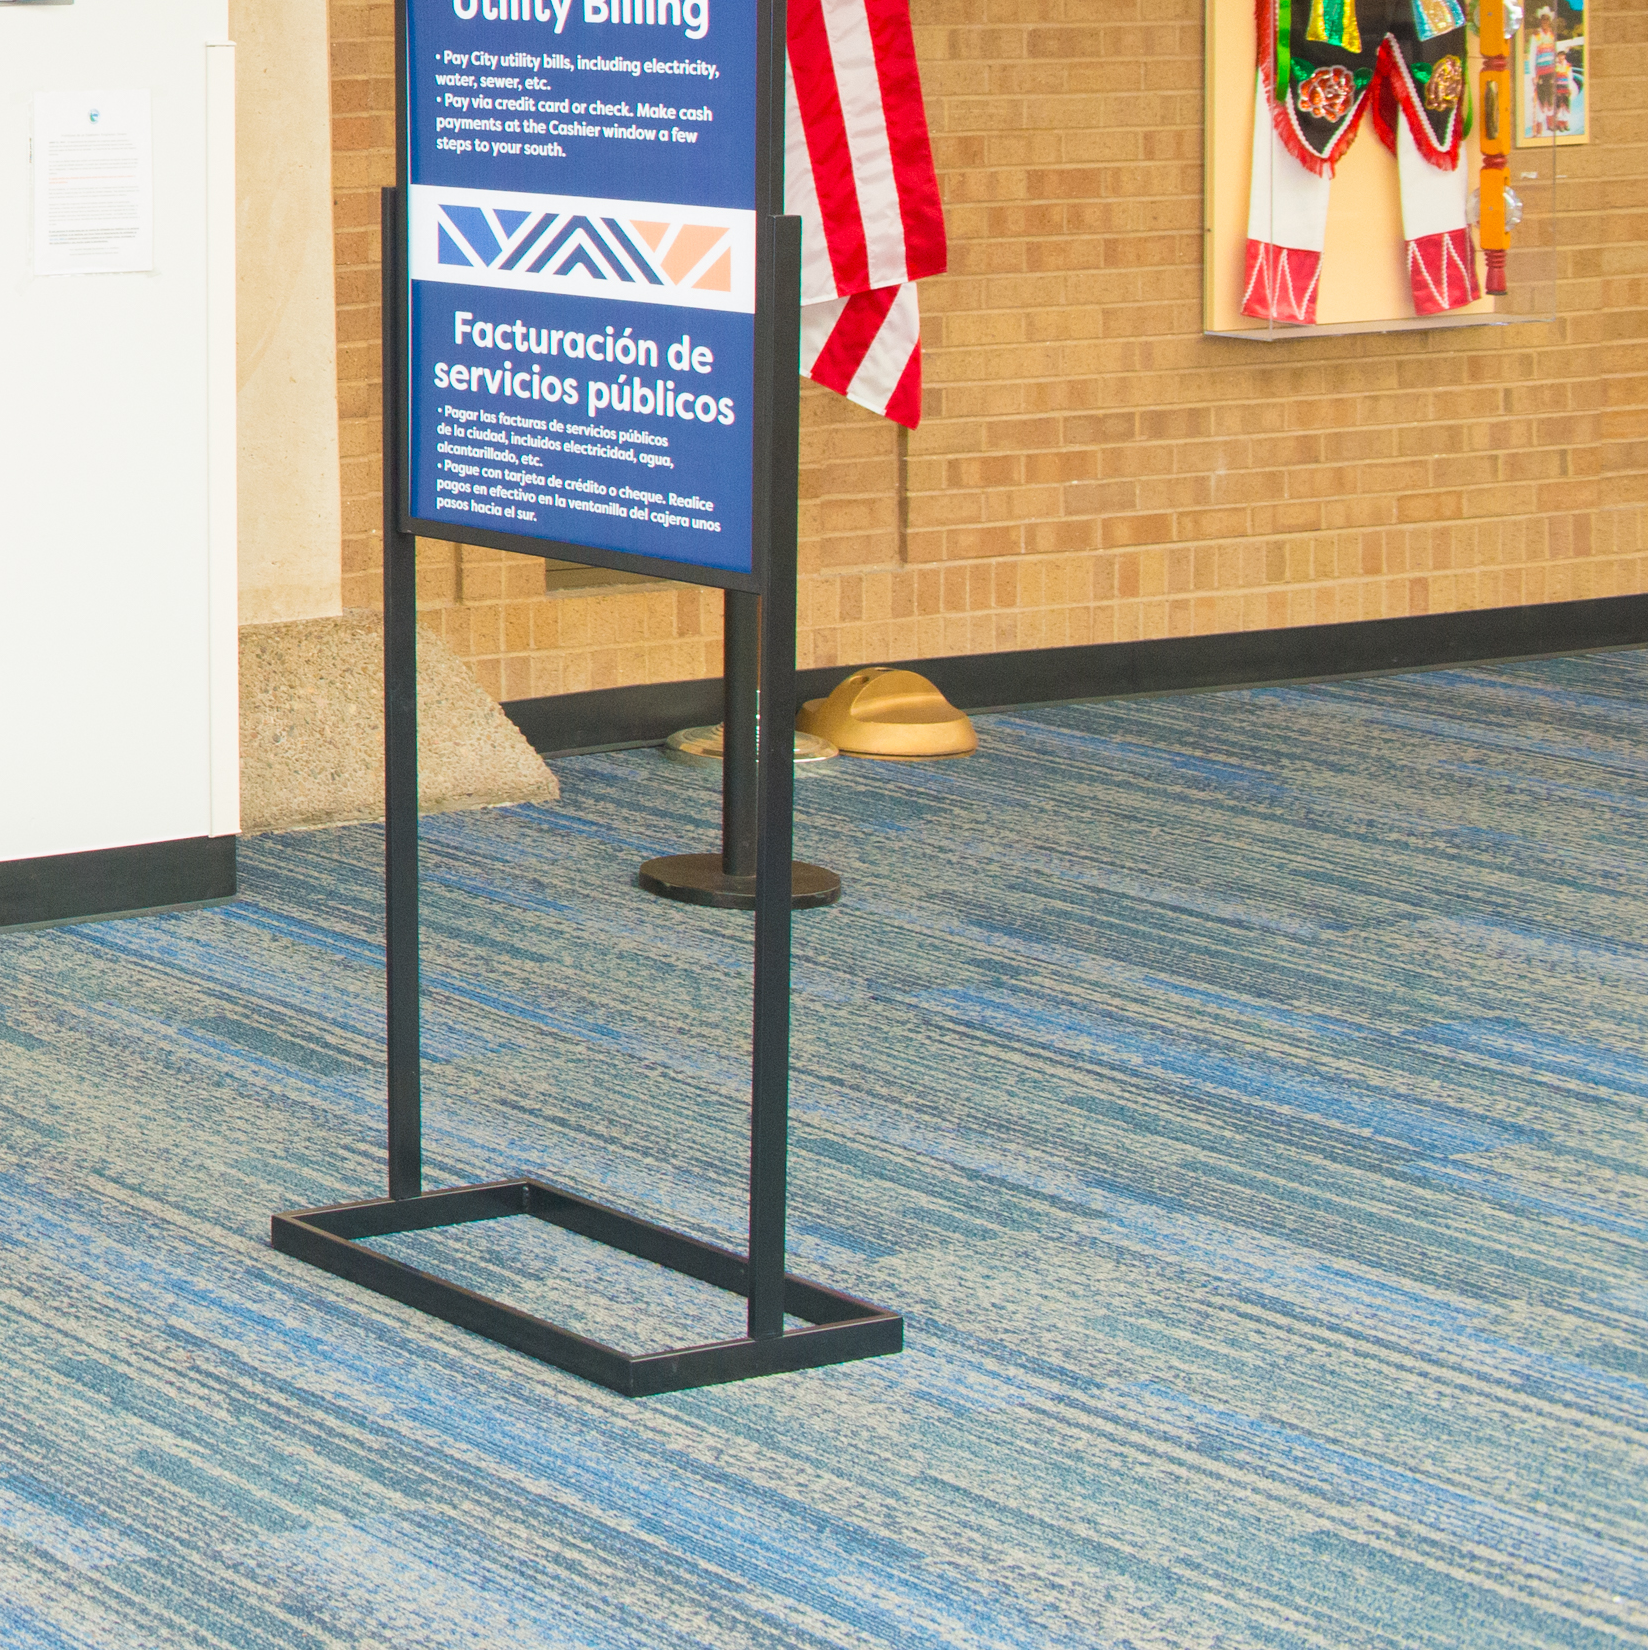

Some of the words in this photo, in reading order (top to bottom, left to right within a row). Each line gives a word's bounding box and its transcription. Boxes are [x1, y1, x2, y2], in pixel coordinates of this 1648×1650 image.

[443, 50, 469, 69] Pay
[471, 51, 498, 70] City
[501, 52, 541, 72] utility
[543, 54, 575, 72] bills,
[577, 55, 641, 76] including
[643, 58, 720, 80] electricity,
[435, 73, 477, 89] water,
[479, 76, 522, 91] sewer,
[525, 77, 551, 90] etc.
[444, 93, 469, 112] Pay
[471, 94, 493, 109] via
[495, 96, 536, 111] credit
[538, 99, 569, 113] card
[571, 102, 587, 114] or
[589, 100, 634, 117] check.
[637, 103, 677, 119] Make
[679, 106, 713, 121] cash
[436, 117, 503, 132] payments
[505, 119, 521, 132] at
[523, 119, 546, 134] the
[549, 120, 601, 137] Cashier
[603, 123, 656, 140] window
[658, 130, 669, 141] a
[671, 127, 698, 143] few
[436, 136, 472, 154] steps
[474, 139, 489, 152] to
[491, 142, 522, 156] your
[523, 142, 566, 157] south.
[454, 310, 658, 368] Facturación
[667, 335, 714, 374] de
[434, 360, 579, 405] servicios
[587, 375, 735, 426] públicos
[445, 405, 479, 422] Pagar
[480, 410, 497, 424] las
[498, 412, 547, 430] facturas
[549, 419, 564, 432] de
[566, 424, 617, 440] servicios
[619, 429, 669, 447] públicos
